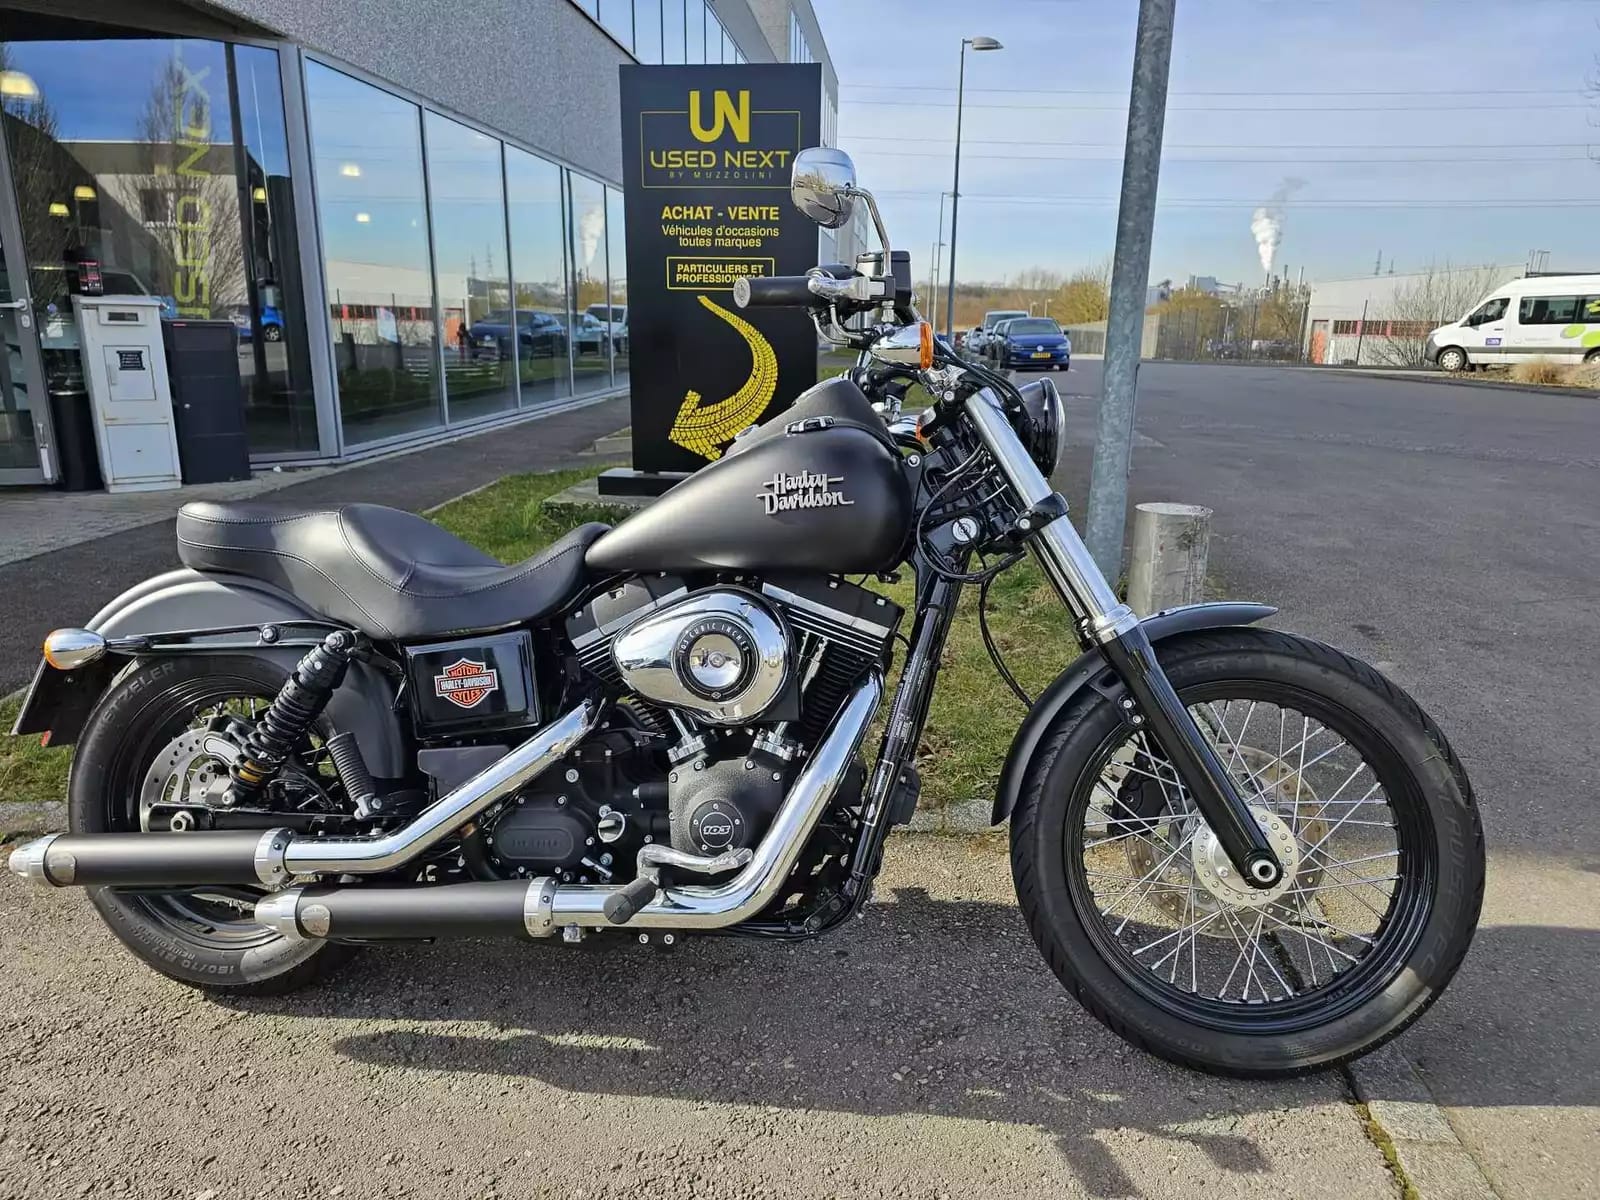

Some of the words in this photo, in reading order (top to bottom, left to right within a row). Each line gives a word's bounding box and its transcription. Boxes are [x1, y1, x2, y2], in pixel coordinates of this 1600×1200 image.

[690, 90, 750, 143] UN
[650, 150, 716, 169] USED
[725, 150, 790, 169] NEXT
[669, 171, 683, 179] BY
[693, 171, 772, 180] MUZZOLINI
[661, 206, 713, 220] ACHAT
[727, 206, 780, 221] VENTE
[661, 224, 713, 237] Véhicules
[715, 224, 779, 237] d'occasions
[679, 236, 712, 248] toutes
[714, 237, 762, 250] marques
[677, 263, 748, 274] PARTICULIERS
[751, 264, 764, 274] ET
[756, 488, 854, 515] Davidson
[689, 622, 717, 638] CUBIC
[721, 623, 750, 652] INCHES
[449, 665, 480, 676] MOTOR
[453, 690, 482, 703] CYCLES
[703, 825, 731, 835] 103
